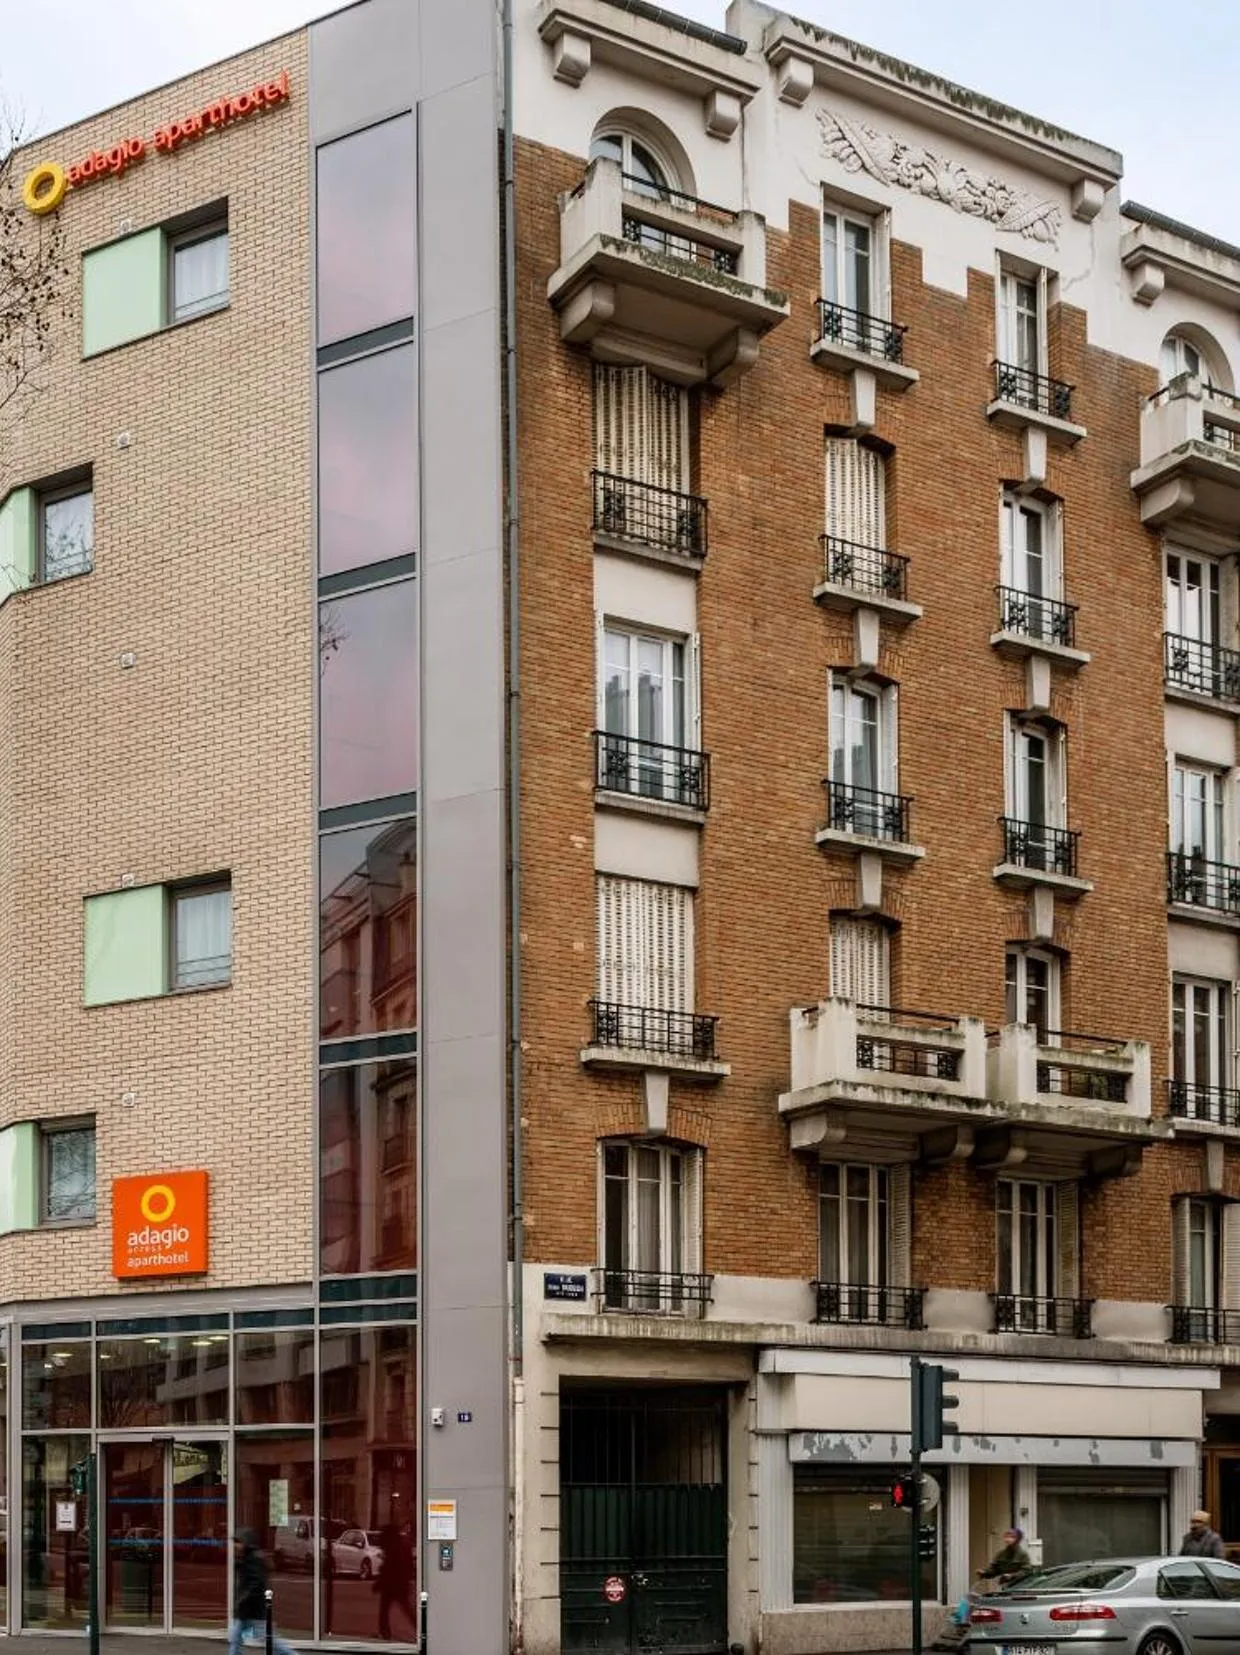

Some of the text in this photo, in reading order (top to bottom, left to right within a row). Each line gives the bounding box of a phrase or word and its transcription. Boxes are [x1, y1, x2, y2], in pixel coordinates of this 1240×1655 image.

[65, 70, 290, 186] adagio aparthotel
[127, 1224, 189, 1248] adagio
[127, 1251, 189, 1268] aparthotel
